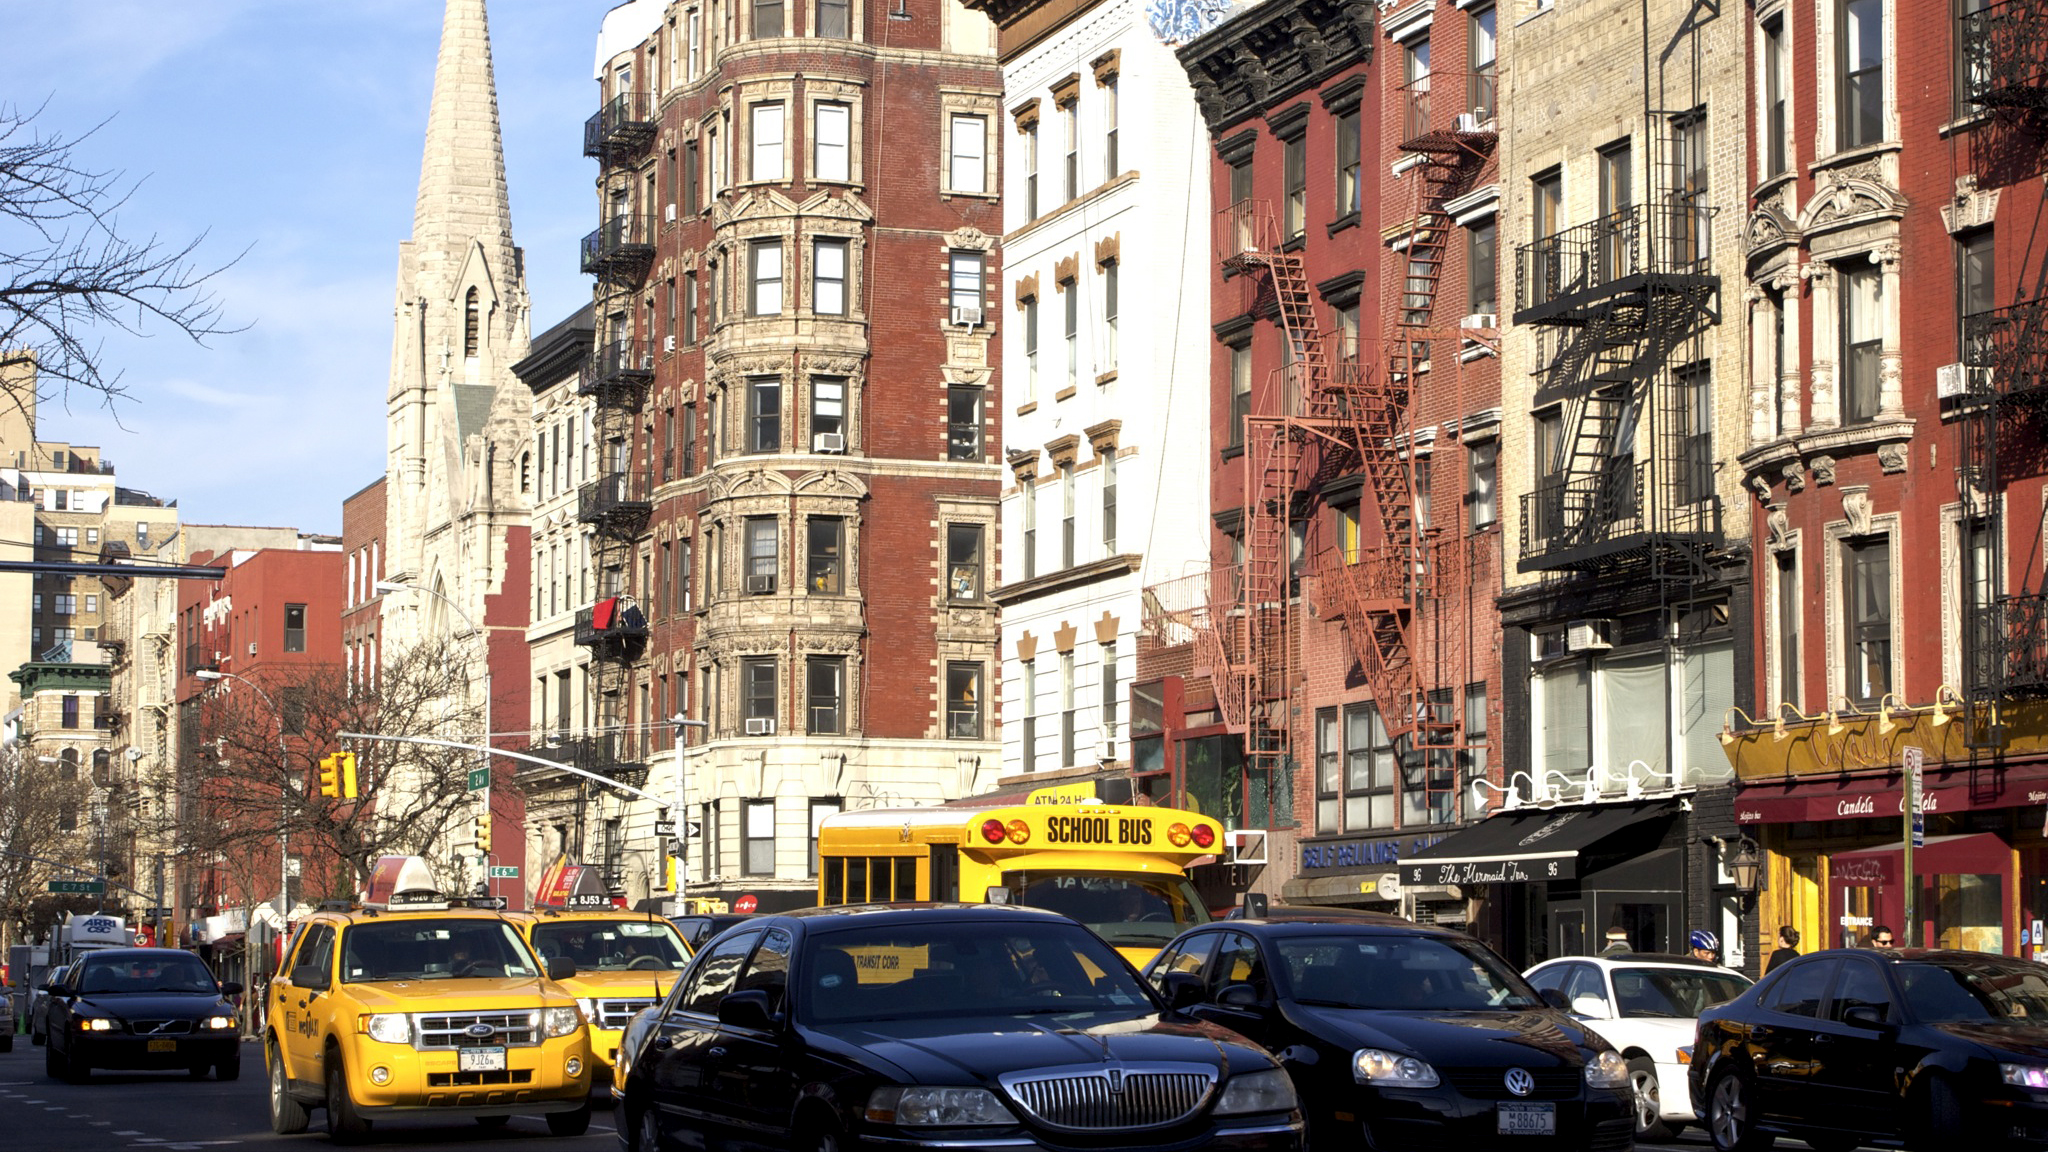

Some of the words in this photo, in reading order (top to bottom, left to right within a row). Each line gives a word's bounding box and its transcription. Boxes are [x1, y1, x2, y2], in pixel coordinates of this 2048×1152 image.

[1060, 796, 1072, 805] 24
[1838, 796, 1874, 815] Candela
[1899, 792, 1937, 812] Cela
[1047, 816, 1113, 844] SCHOOL
[1118, 818, 1152, 845] BUS
[1303, 845, 1336, 868] SELF
[1338, 840, 1400, 867] RELIANCE
[495, 868, 500, 876] E
[502, 868, 508, 876] 6
[1413, 867, 1422, 882] 96
[1439, 863, 1460, 884] The
[1463, 862, 1506, 883] Mermaid
[1507, 861, 1528, 881] Inn
[1548, 861, 1558, 877] 96
[62, 883, 68, 891] E
[70, 883, 77, 891] 7
[80, 883, 90, 891] St
[580, 895, 600, 905] 8J53
[82, 918, 117, 928] ARRI
[87, 926, 111, 934] CSC
[2034, 922, 2042, 938] A
[857, 954, 881, 969] TRANSIT
[882, 954, 900, 969] CORP.
[1517, 1112, 1546, 1129] 88675
